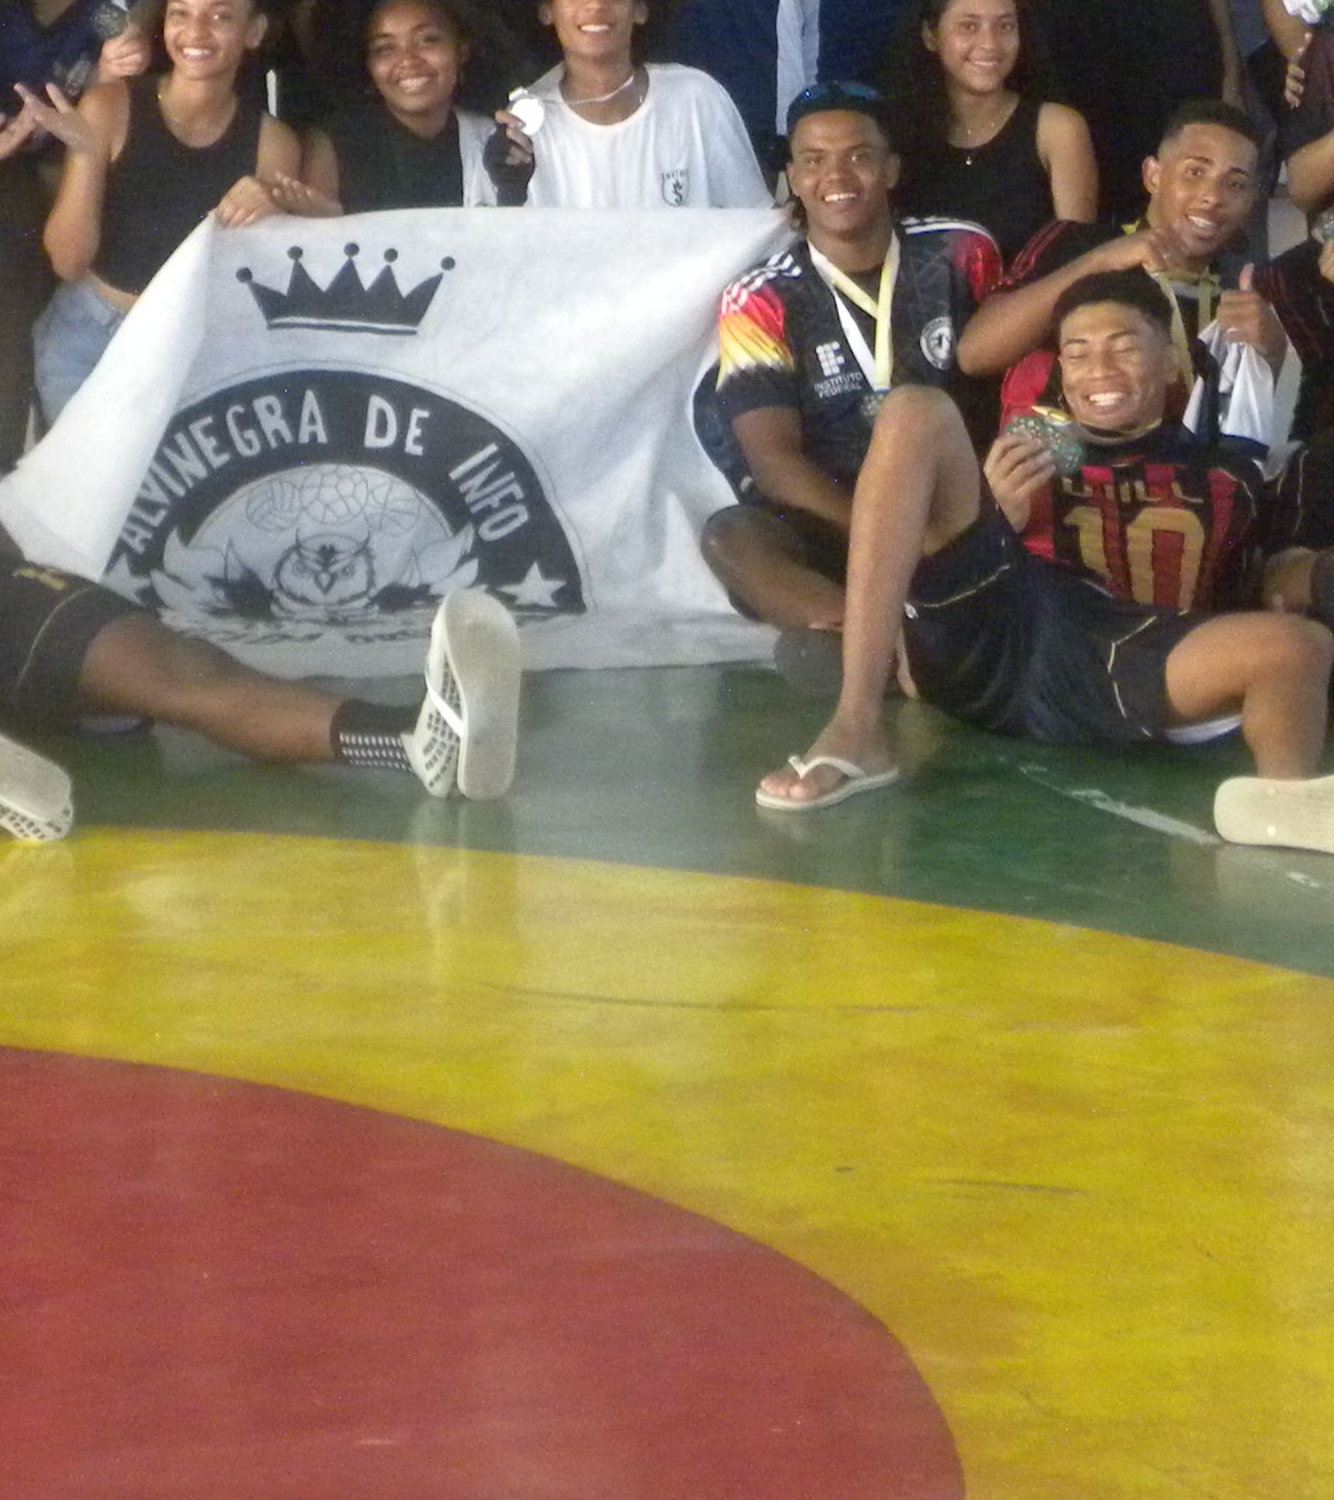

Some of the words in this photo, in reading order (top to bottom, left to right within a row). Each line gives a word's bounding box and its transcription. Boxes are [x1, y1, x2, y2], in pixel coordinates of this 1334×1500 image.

[119, 389, 329, 555] ALVINEGRA
[365, 394, 430, 457] DE
[448, 442, 529, 542] INFO
[1064, 506, 1205, 616] 10
